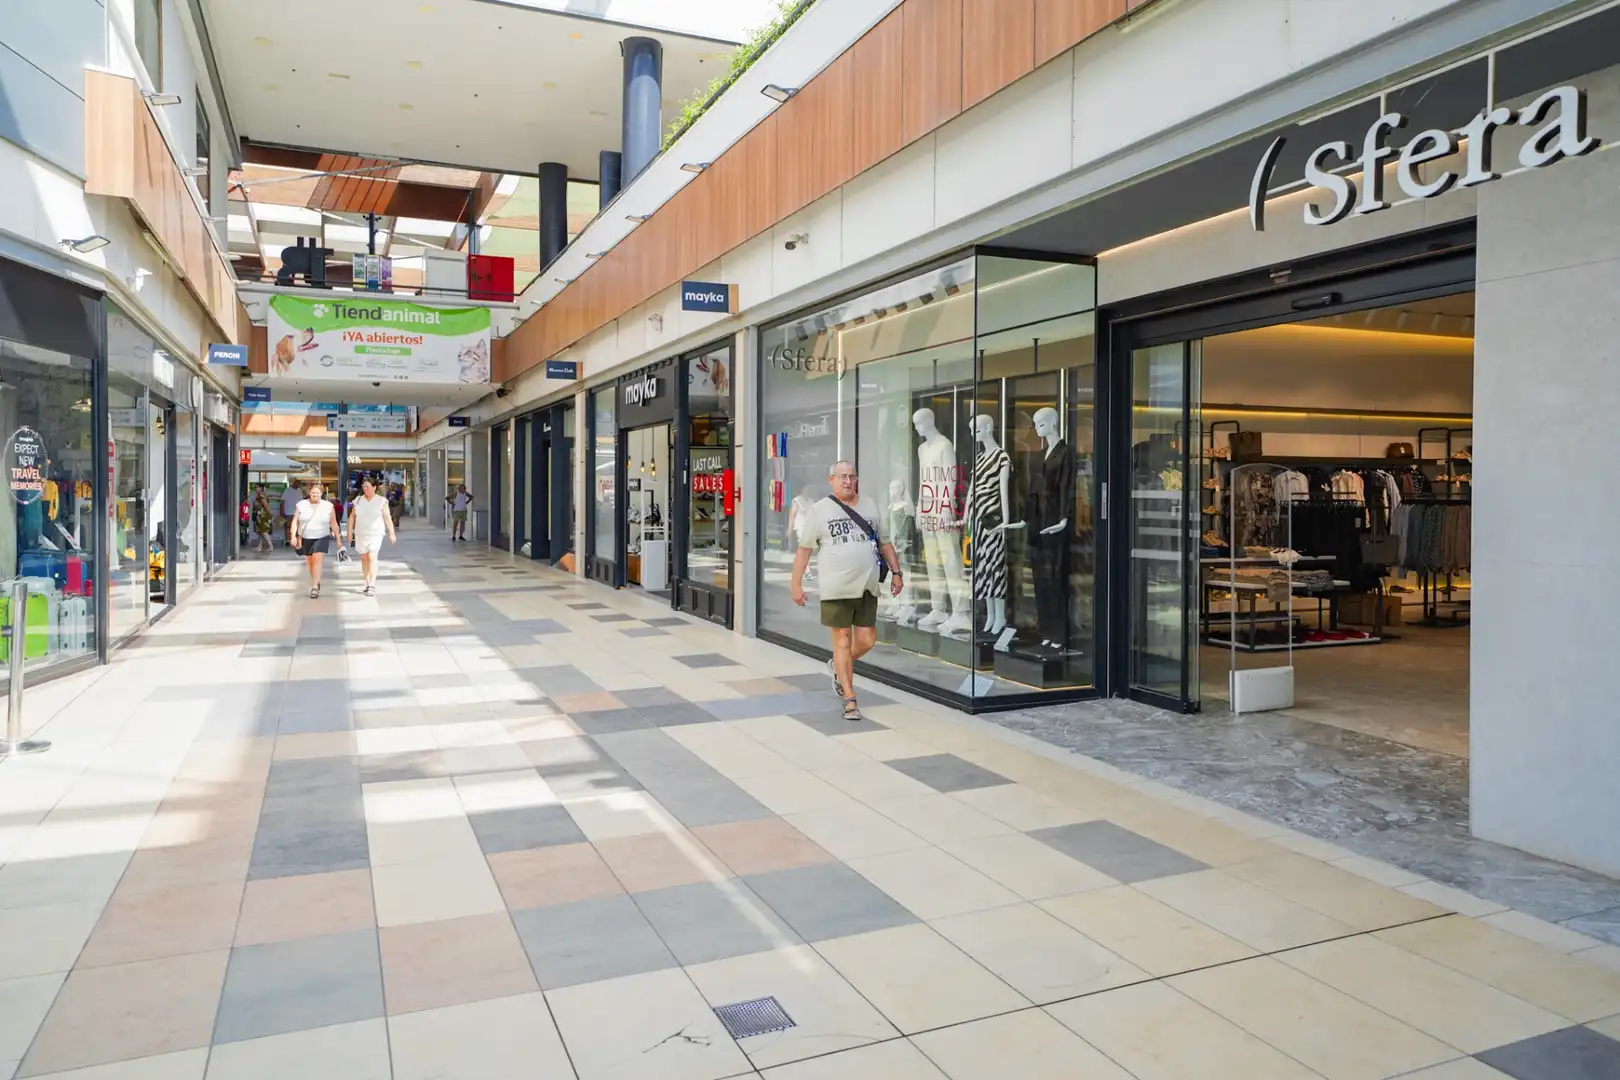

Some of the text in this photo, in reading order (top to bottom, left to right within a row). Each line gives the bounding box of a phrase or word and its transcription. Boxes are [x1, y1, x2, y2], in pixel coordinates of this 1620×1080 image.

[684, 291, 725, 304] mayka
[332, 304, 441, 325] Tiendanimal
[366, 332, 424, 345] abiertos!
[625, 373, 657, 407] mayka
[14, 443, 40, 454] EXPECT
[18, 456, 36, 466] NEW
[692, 455, 722, 471] LAST CALL
[11, 467, 42, 479] TRAVEL
[10, 482, 43, 491] MEMORIES
[693, 476, 723, 490] SALES
[920, 484, 967, 516] DIAS
